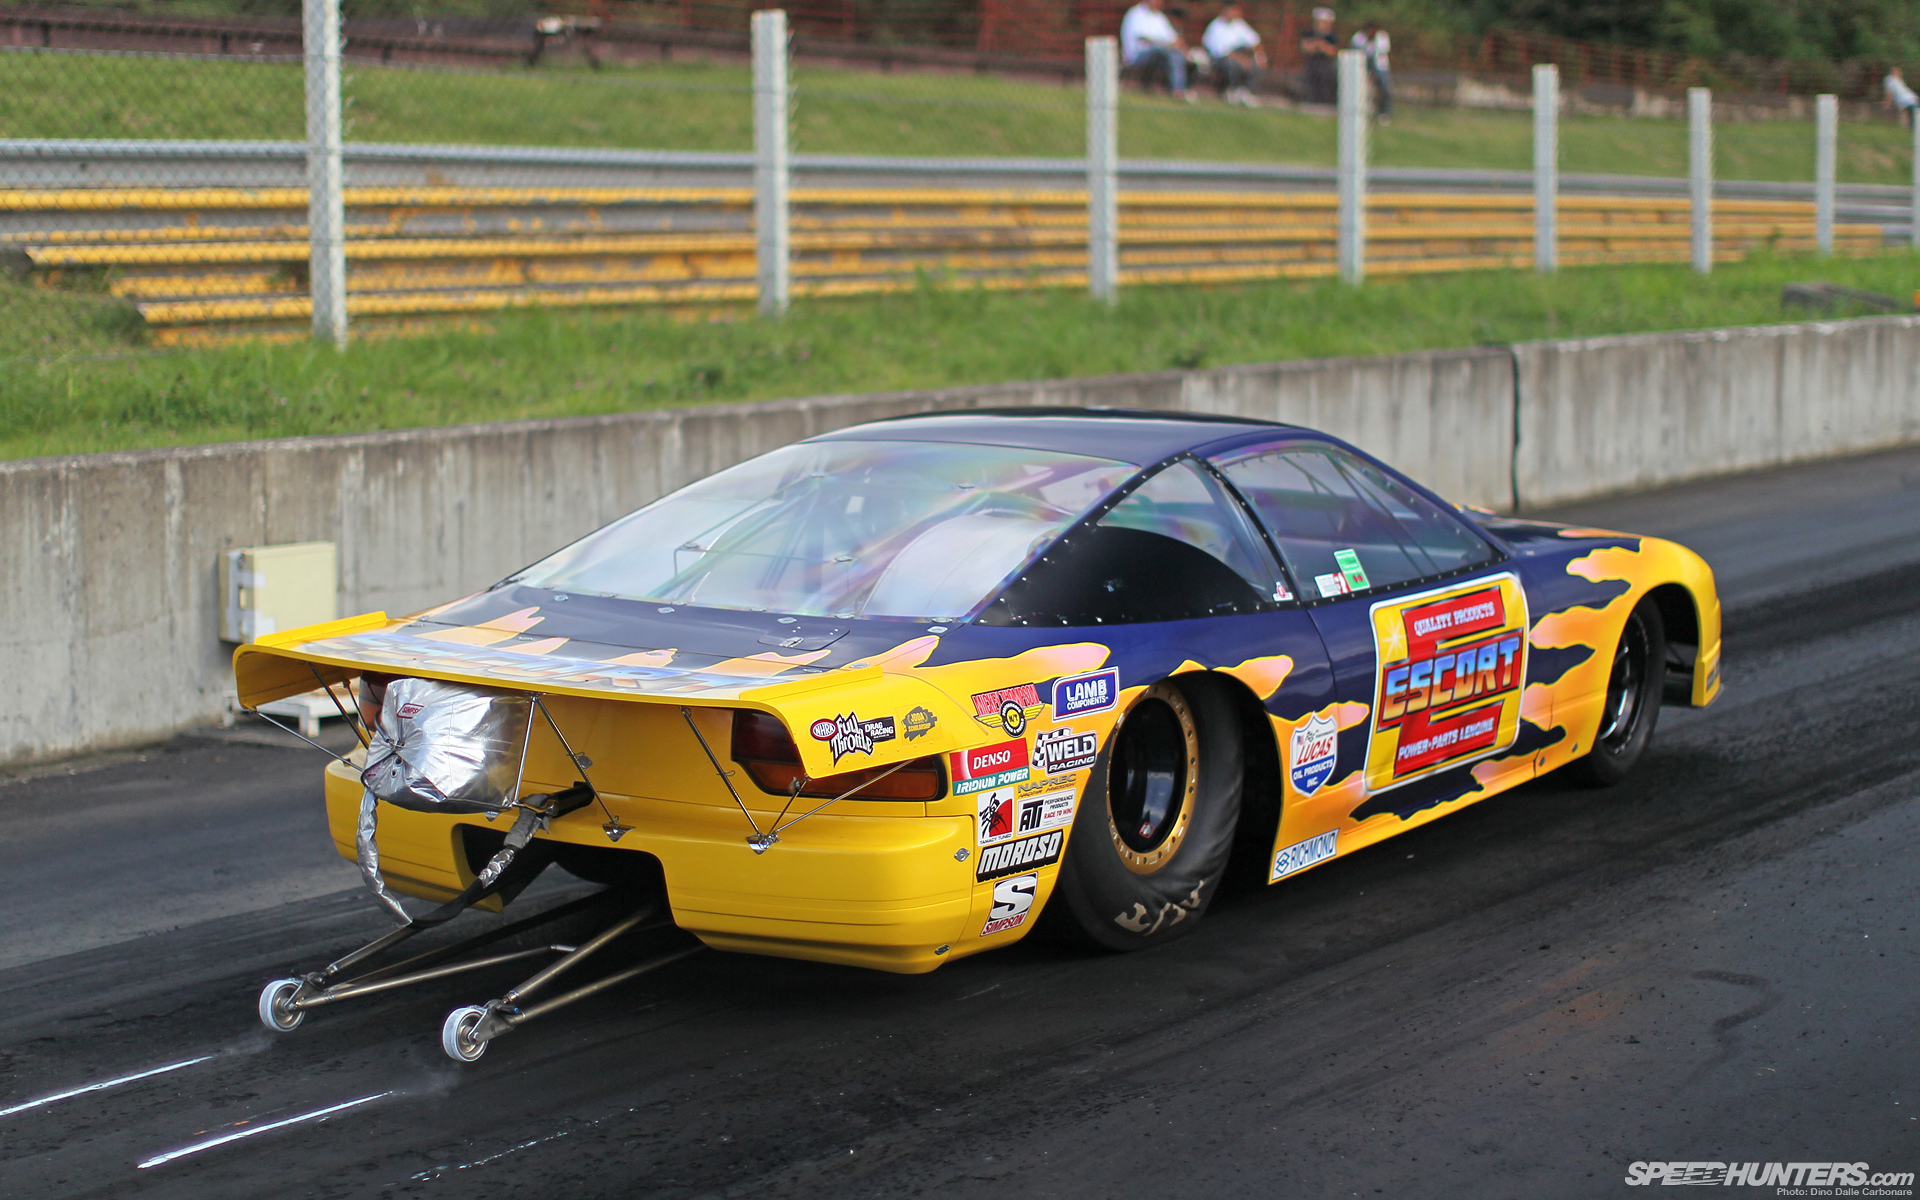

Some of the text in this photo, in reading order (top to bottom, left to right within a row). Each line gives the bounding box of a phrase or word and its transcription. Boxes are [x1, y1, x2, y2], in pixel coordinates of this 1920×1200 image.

[1414, 601, 1495, 636] QUALITY PRODUCTS
[1382, 636, 1520, 721] ESCORT
[998, 684, 1040, 708] THOMPSON
[1065, 679, 1107, 701] LAMB
[1067, 695, 1107, 710] COMPONENTS
[813, 720, 836, 738] NHRA
[865, 721, 883, 733] DRAG
[871, 726, 894, 737] RACING
[1047, 735, 1096, 762] WELD
[1297, 736, 1333, 765] LUCAS
[973, 750, 1011, 769] DENSO
[1049, 756, 1095, 772] RACING
[1293, 759, 1333, 780] OIL PRODUCTS
[957, 768, 1028, 794] IRIDIUM POWER
[1018, 774, 1076, 793] NAPREC
[1045, 795, 1073, 805] PERFORMANCE
[1050, 801, 1068, 809] PRODUCTS
[1044, 811, 1055, 819] RACE
[978, 831, 1062, 874] MOROSO
[1290, 832, 1336, 870] RICHMOND
[990, 875, 1037, 920] S
[983, 912, 1027, 935] SIMPSON
